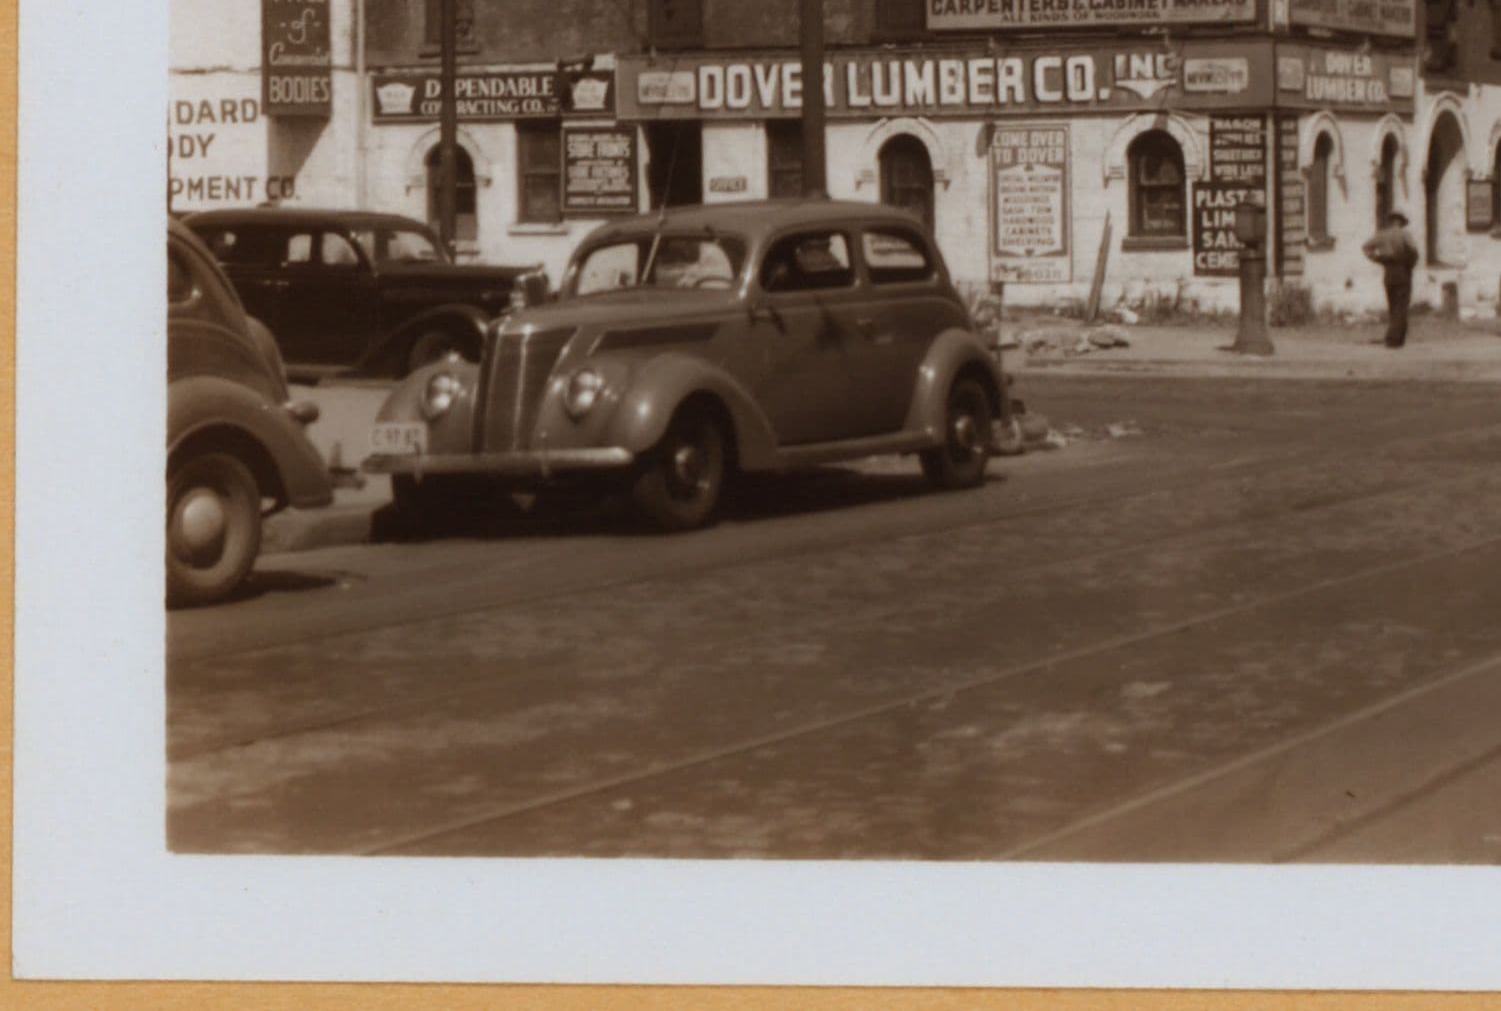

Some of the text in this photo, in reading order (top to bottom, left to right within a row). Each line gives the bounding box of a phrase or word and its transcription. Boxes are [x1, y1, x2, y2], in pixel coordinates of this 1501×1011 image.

[269, 76, 330, 103] BODIES
[425, 75, 554, 99] DPENDABLE
[699, 62, 836, 109] DOVE
[847, 54, 1025, 107] LUMBER
[1034, 55, 1111, 103] CO.
[168, 98, 259, 125] DARD
[419, 96, 519, 116] CORACTING
[995, 148, 1013, 165] TO
[265, 175, 302, 201] CO.
[1202, 211, 1237, 229] LIM
